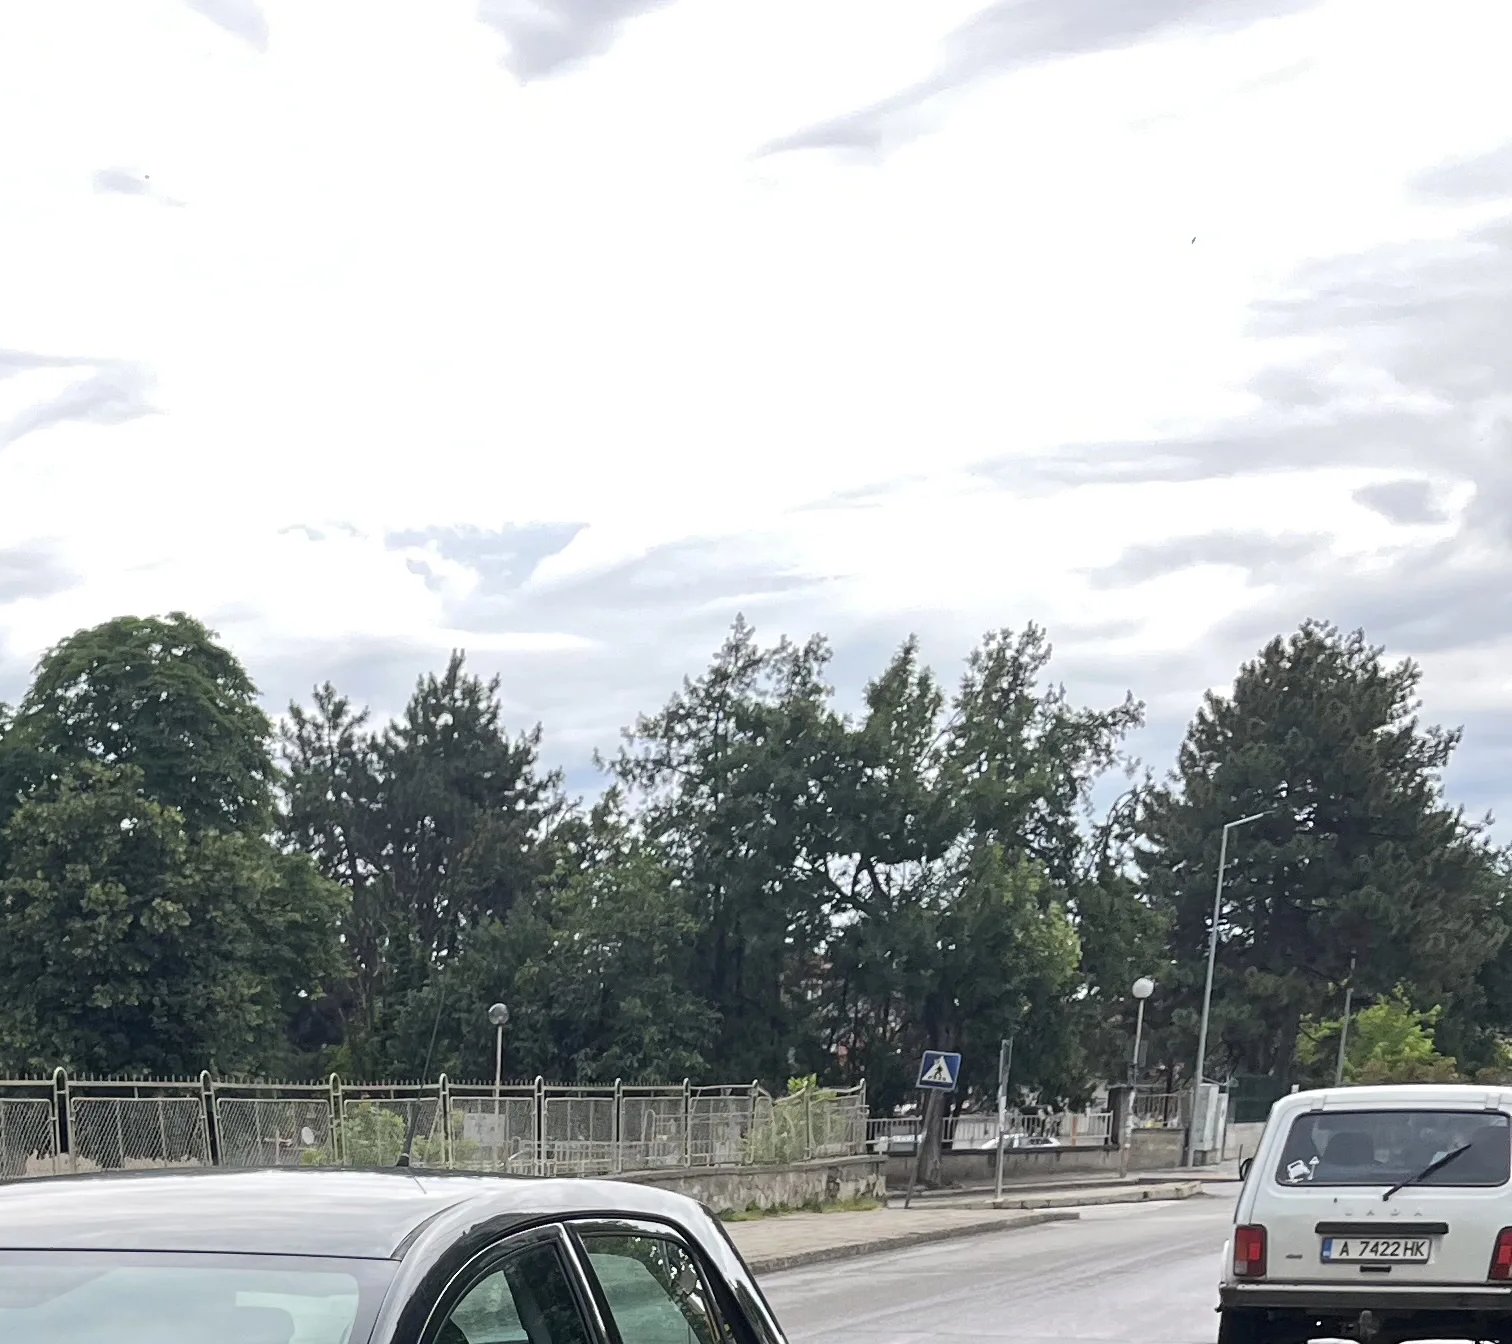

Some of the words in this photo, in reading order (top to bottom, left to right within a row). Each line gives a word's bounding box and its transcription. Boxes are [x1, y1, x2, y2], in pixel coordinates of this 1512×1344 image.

[1339, 1241, 1349, 1256] A
[1358, 1241, 1401, 1256] 7422
[1403, 1241, 1426, 1256] HK
